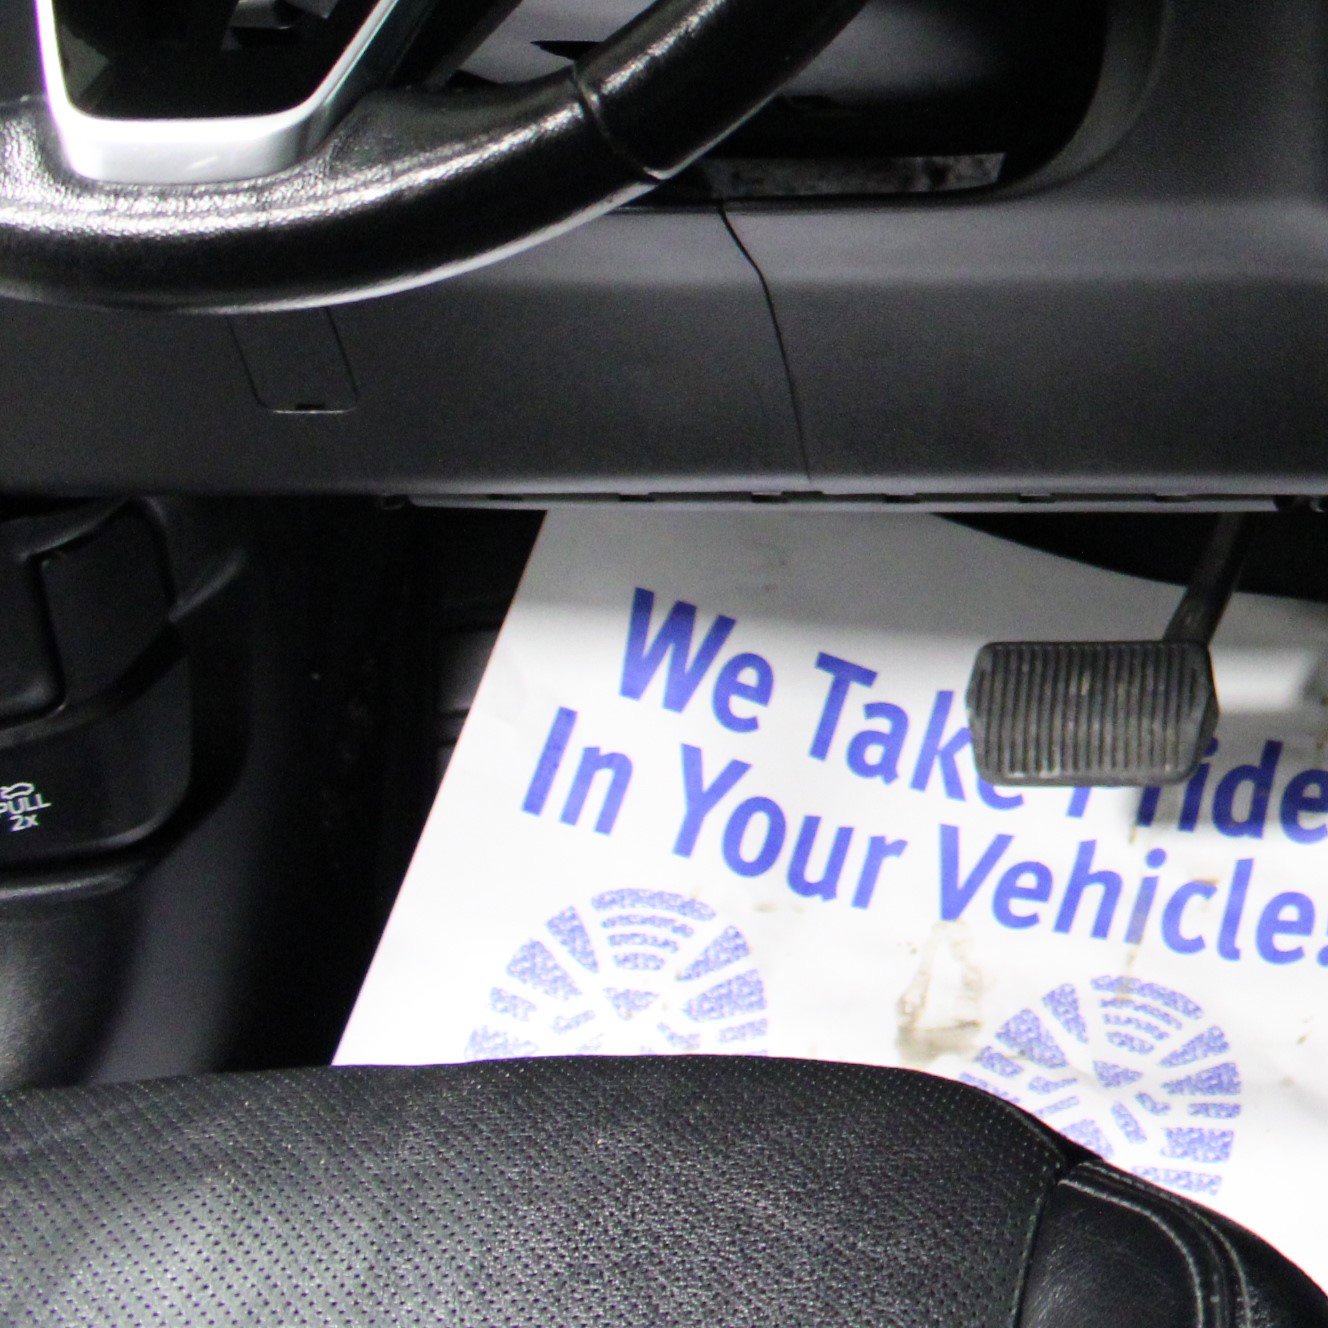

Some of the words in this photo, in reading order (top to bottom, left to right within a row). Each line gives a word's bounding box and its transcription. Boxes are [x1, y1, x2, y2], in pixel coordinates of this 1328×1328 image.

[619, 587, 774, 733] We
[521, 706, 633, 836] In
[672, 743, 908, 909] Your
